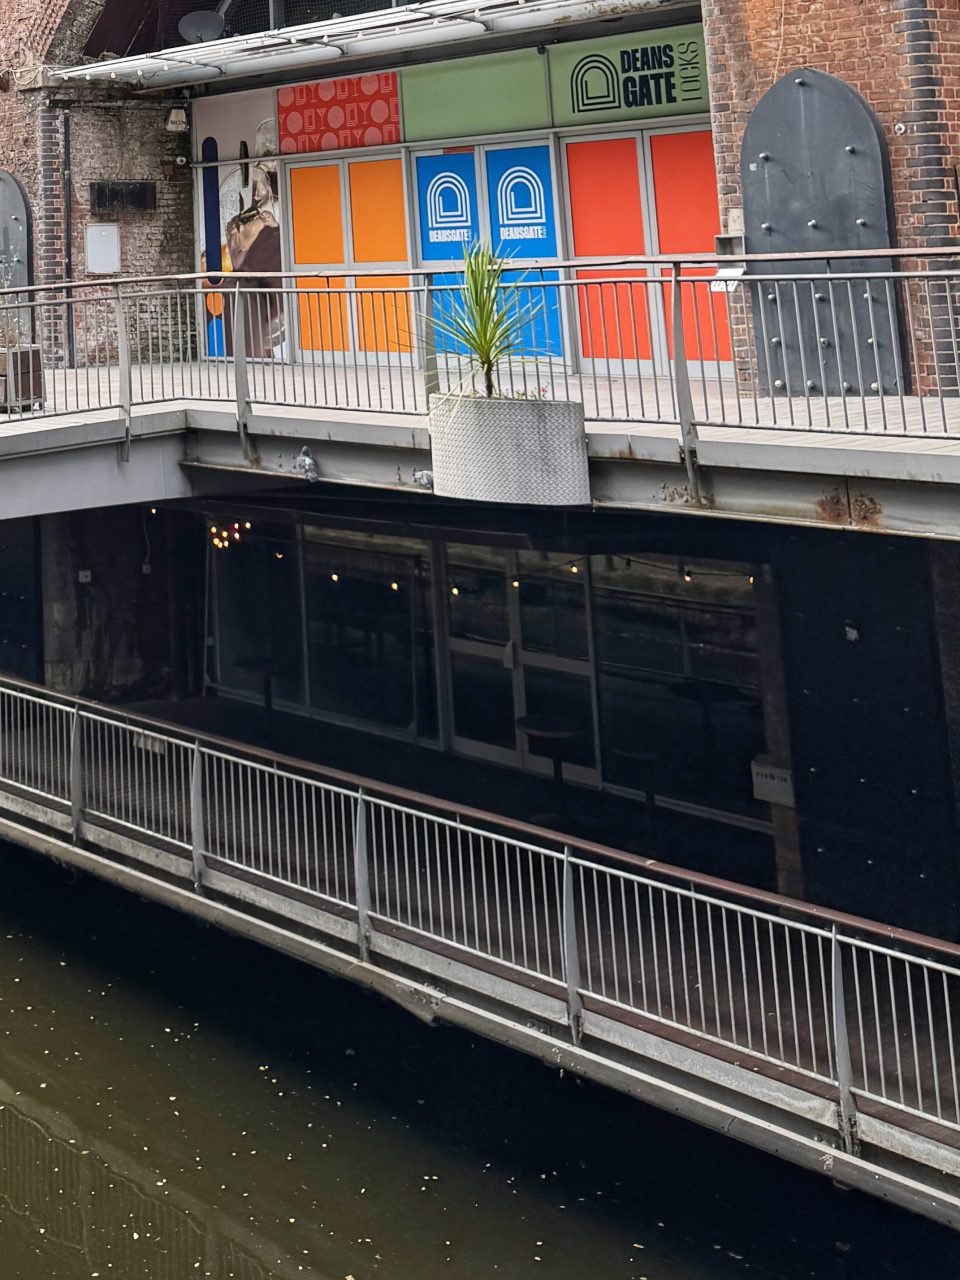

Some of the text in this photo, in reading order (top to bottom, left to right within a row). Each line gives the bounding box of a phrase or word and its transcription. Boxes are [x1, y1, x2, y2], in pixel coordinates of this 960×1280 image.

[620, 44, 675, 74] DEANS
[677, 41, 702, 101] LOCKS
[623, 71, 678, 108] GATE
[429, 229, 469, 242] DEANSGATE
[500, 225, 543, 240] DEANSGATE
